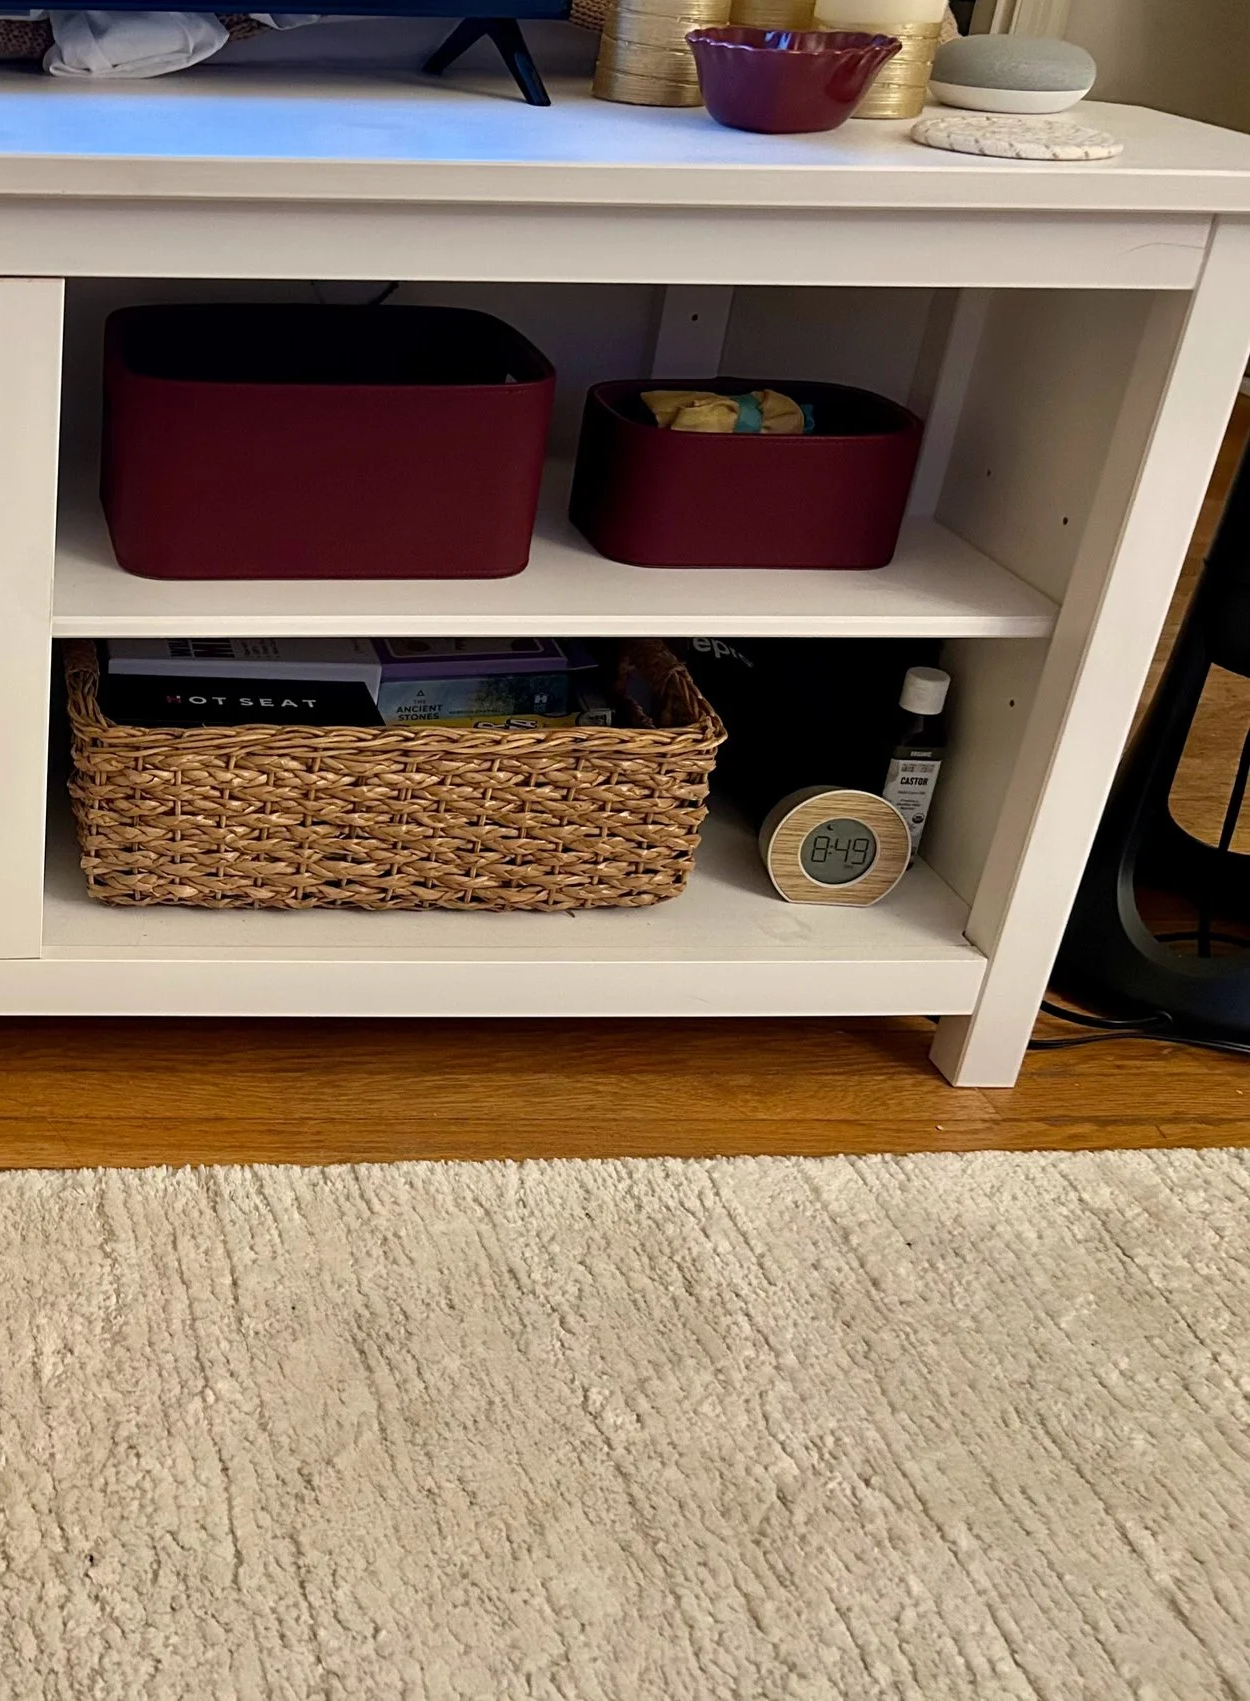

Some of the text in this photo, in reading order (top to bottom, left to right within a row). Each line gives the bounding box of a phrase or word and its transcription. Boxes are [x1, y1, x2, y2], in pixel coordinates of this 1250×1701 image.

[165, 694, 318, 709] HOT SEAT
[396, 704, 442, 714] ANCIENT
[398, 712, 440, 722] STONES
[899, 776, 930, 787] CASTOR
[810, 835, 870, 865] 8:49
